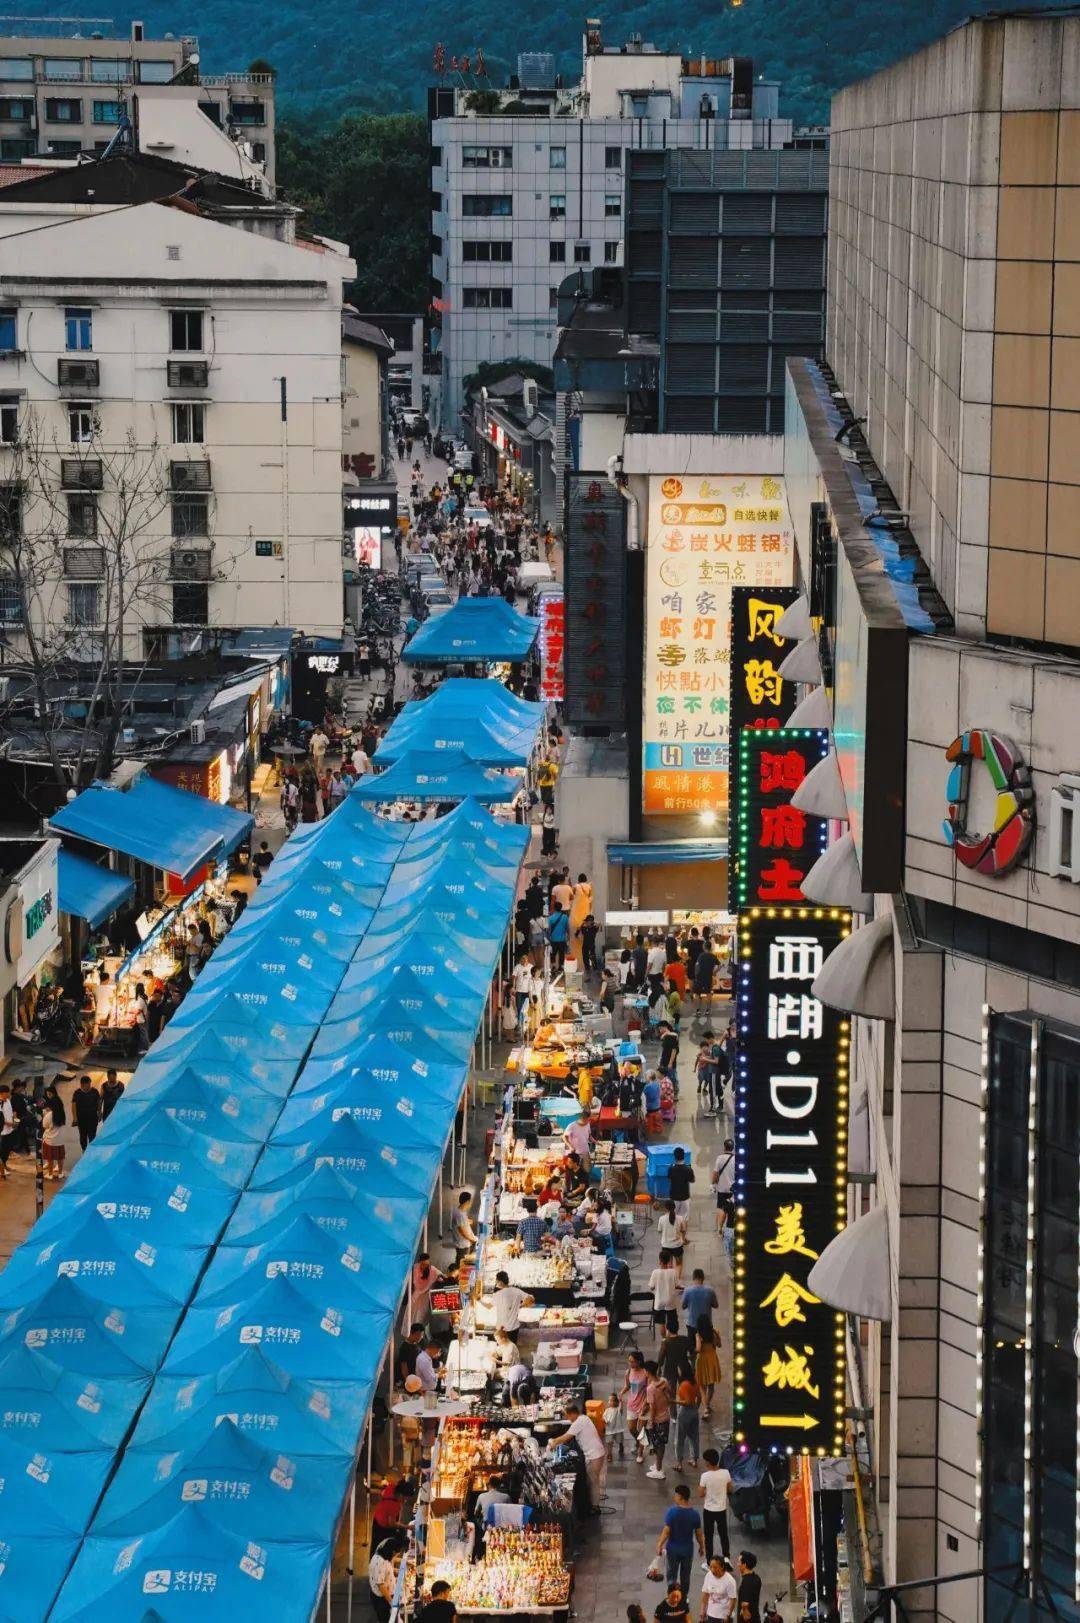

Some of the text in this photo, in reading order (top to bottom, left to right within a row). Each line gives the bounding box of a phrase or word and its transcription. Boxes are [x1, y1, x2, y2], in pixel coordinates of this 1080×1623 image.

[734, 509, 780, 522] 自选快餐
[661, 591, 731, 615] 咱家
[659, 617, 731, 640] 虾灯
[656, 671, 731, 692] 快點小
[352, 1107, 382, 1117] 支付宝
[119, 1204, 151, 1215] 支付宝
[82, 1260, 116, 1271] 支付宝
[289, 1262, 324, 1275] 支付宝
[50, 1327, 86, 1338] 支付宝
[265, 1327, 301, 1338] 支付宝
[241, 1413, 279, 1425] 支付宝
[210, 1481, 251, 1494] 支付宝
[173, 1571, 218, 1586] 支付宝
[173, 1584, 216, 1593] ALIPAY
